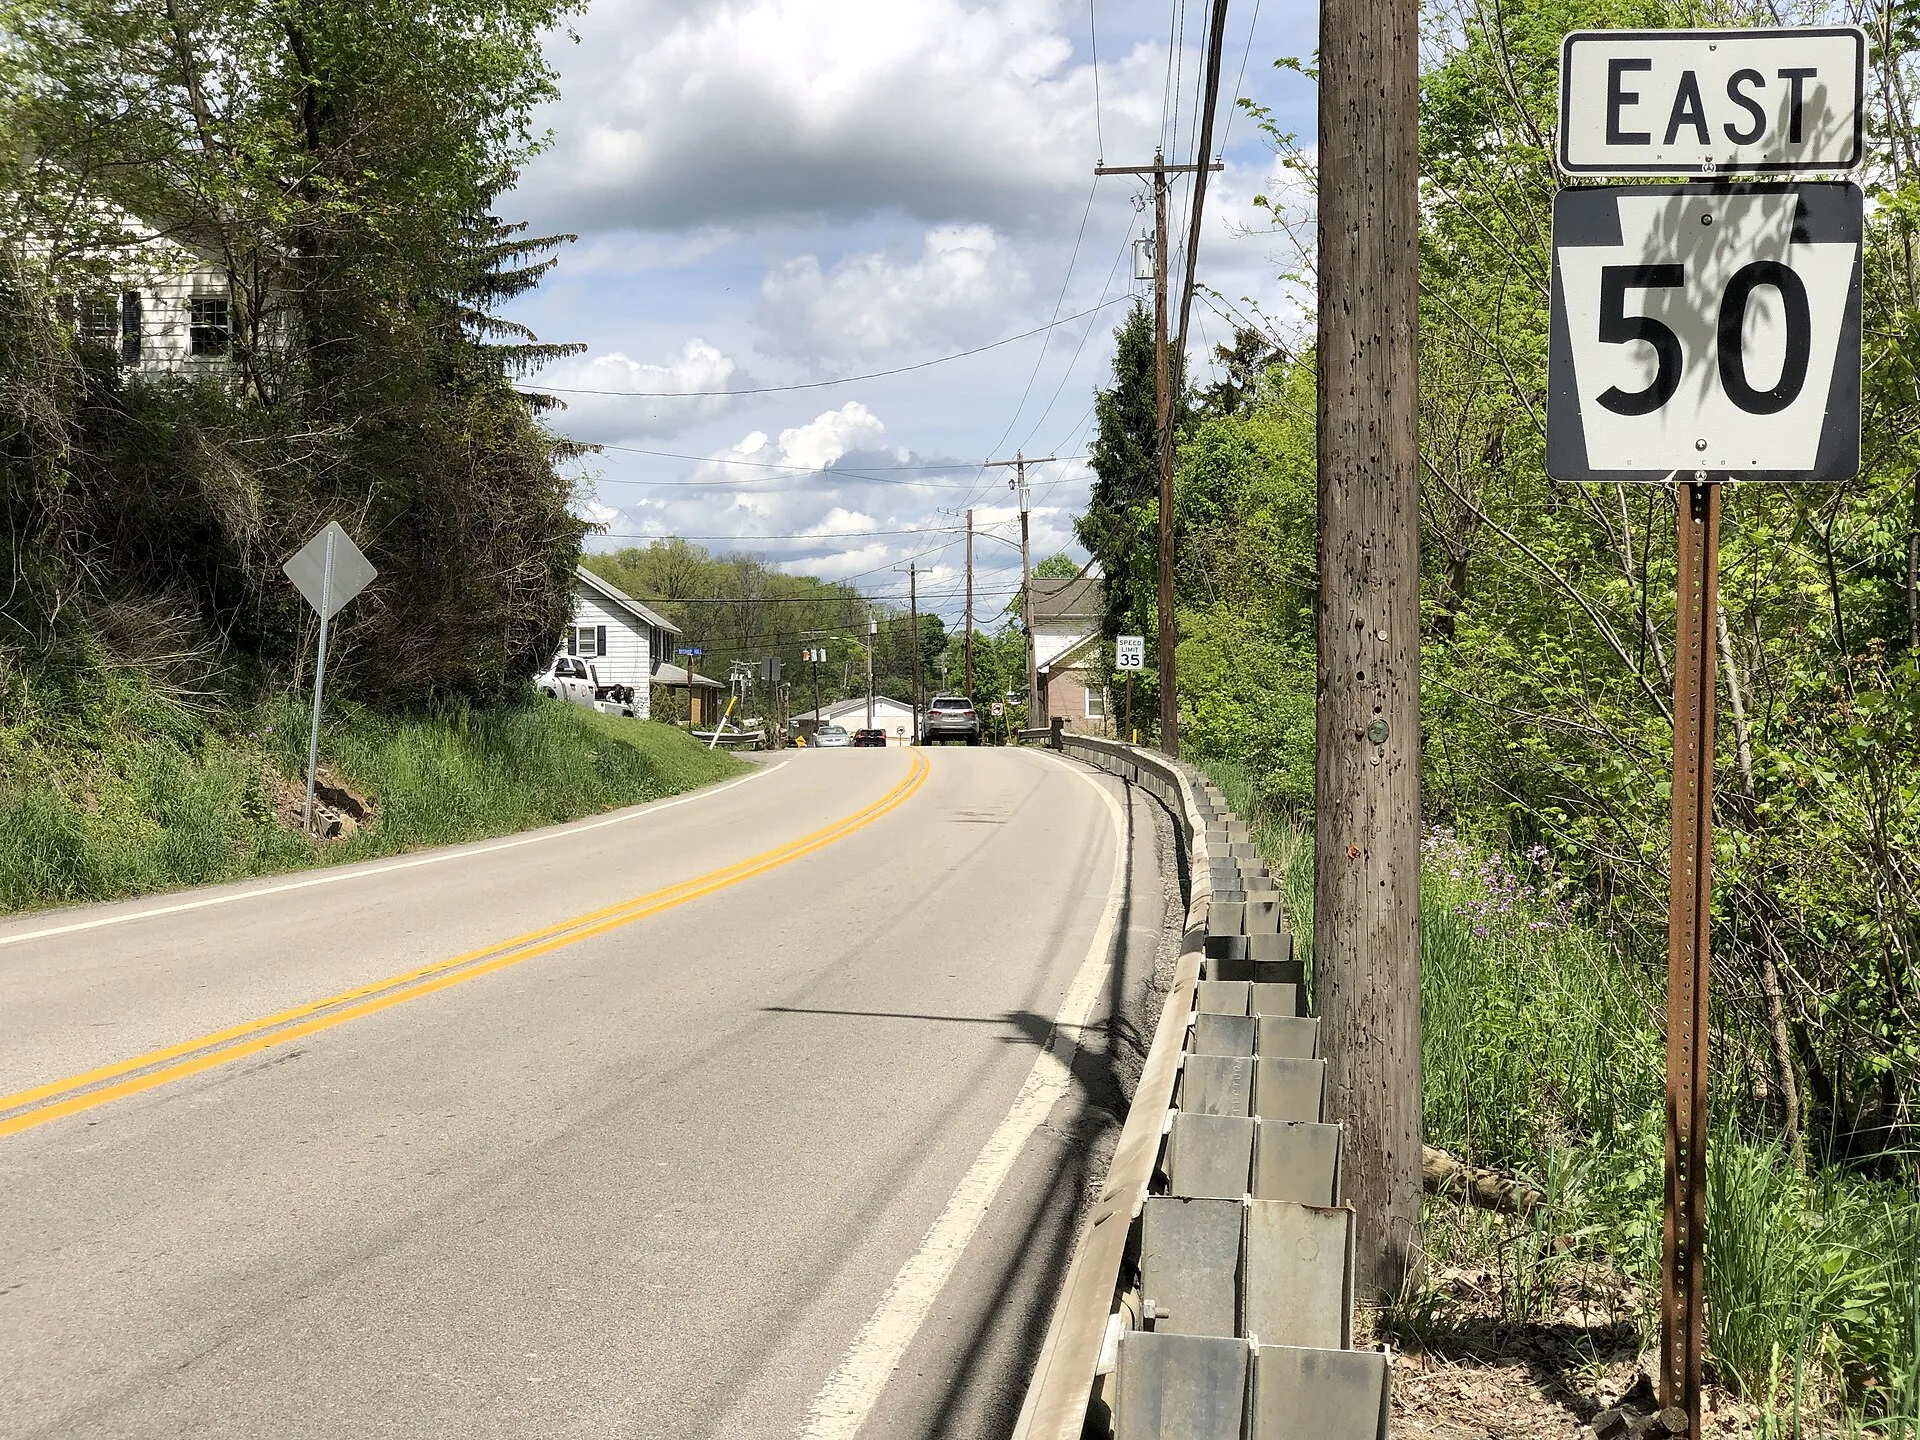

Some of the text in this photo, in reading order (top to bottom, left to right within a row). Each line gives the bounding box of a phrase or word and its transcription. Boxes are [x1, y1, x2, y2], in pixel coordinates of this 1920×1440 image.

[1605, 58, 1817, 146] EAST
[1595, 260, 1811, 416] 50
[1120, 654, 1140, 666] 35
